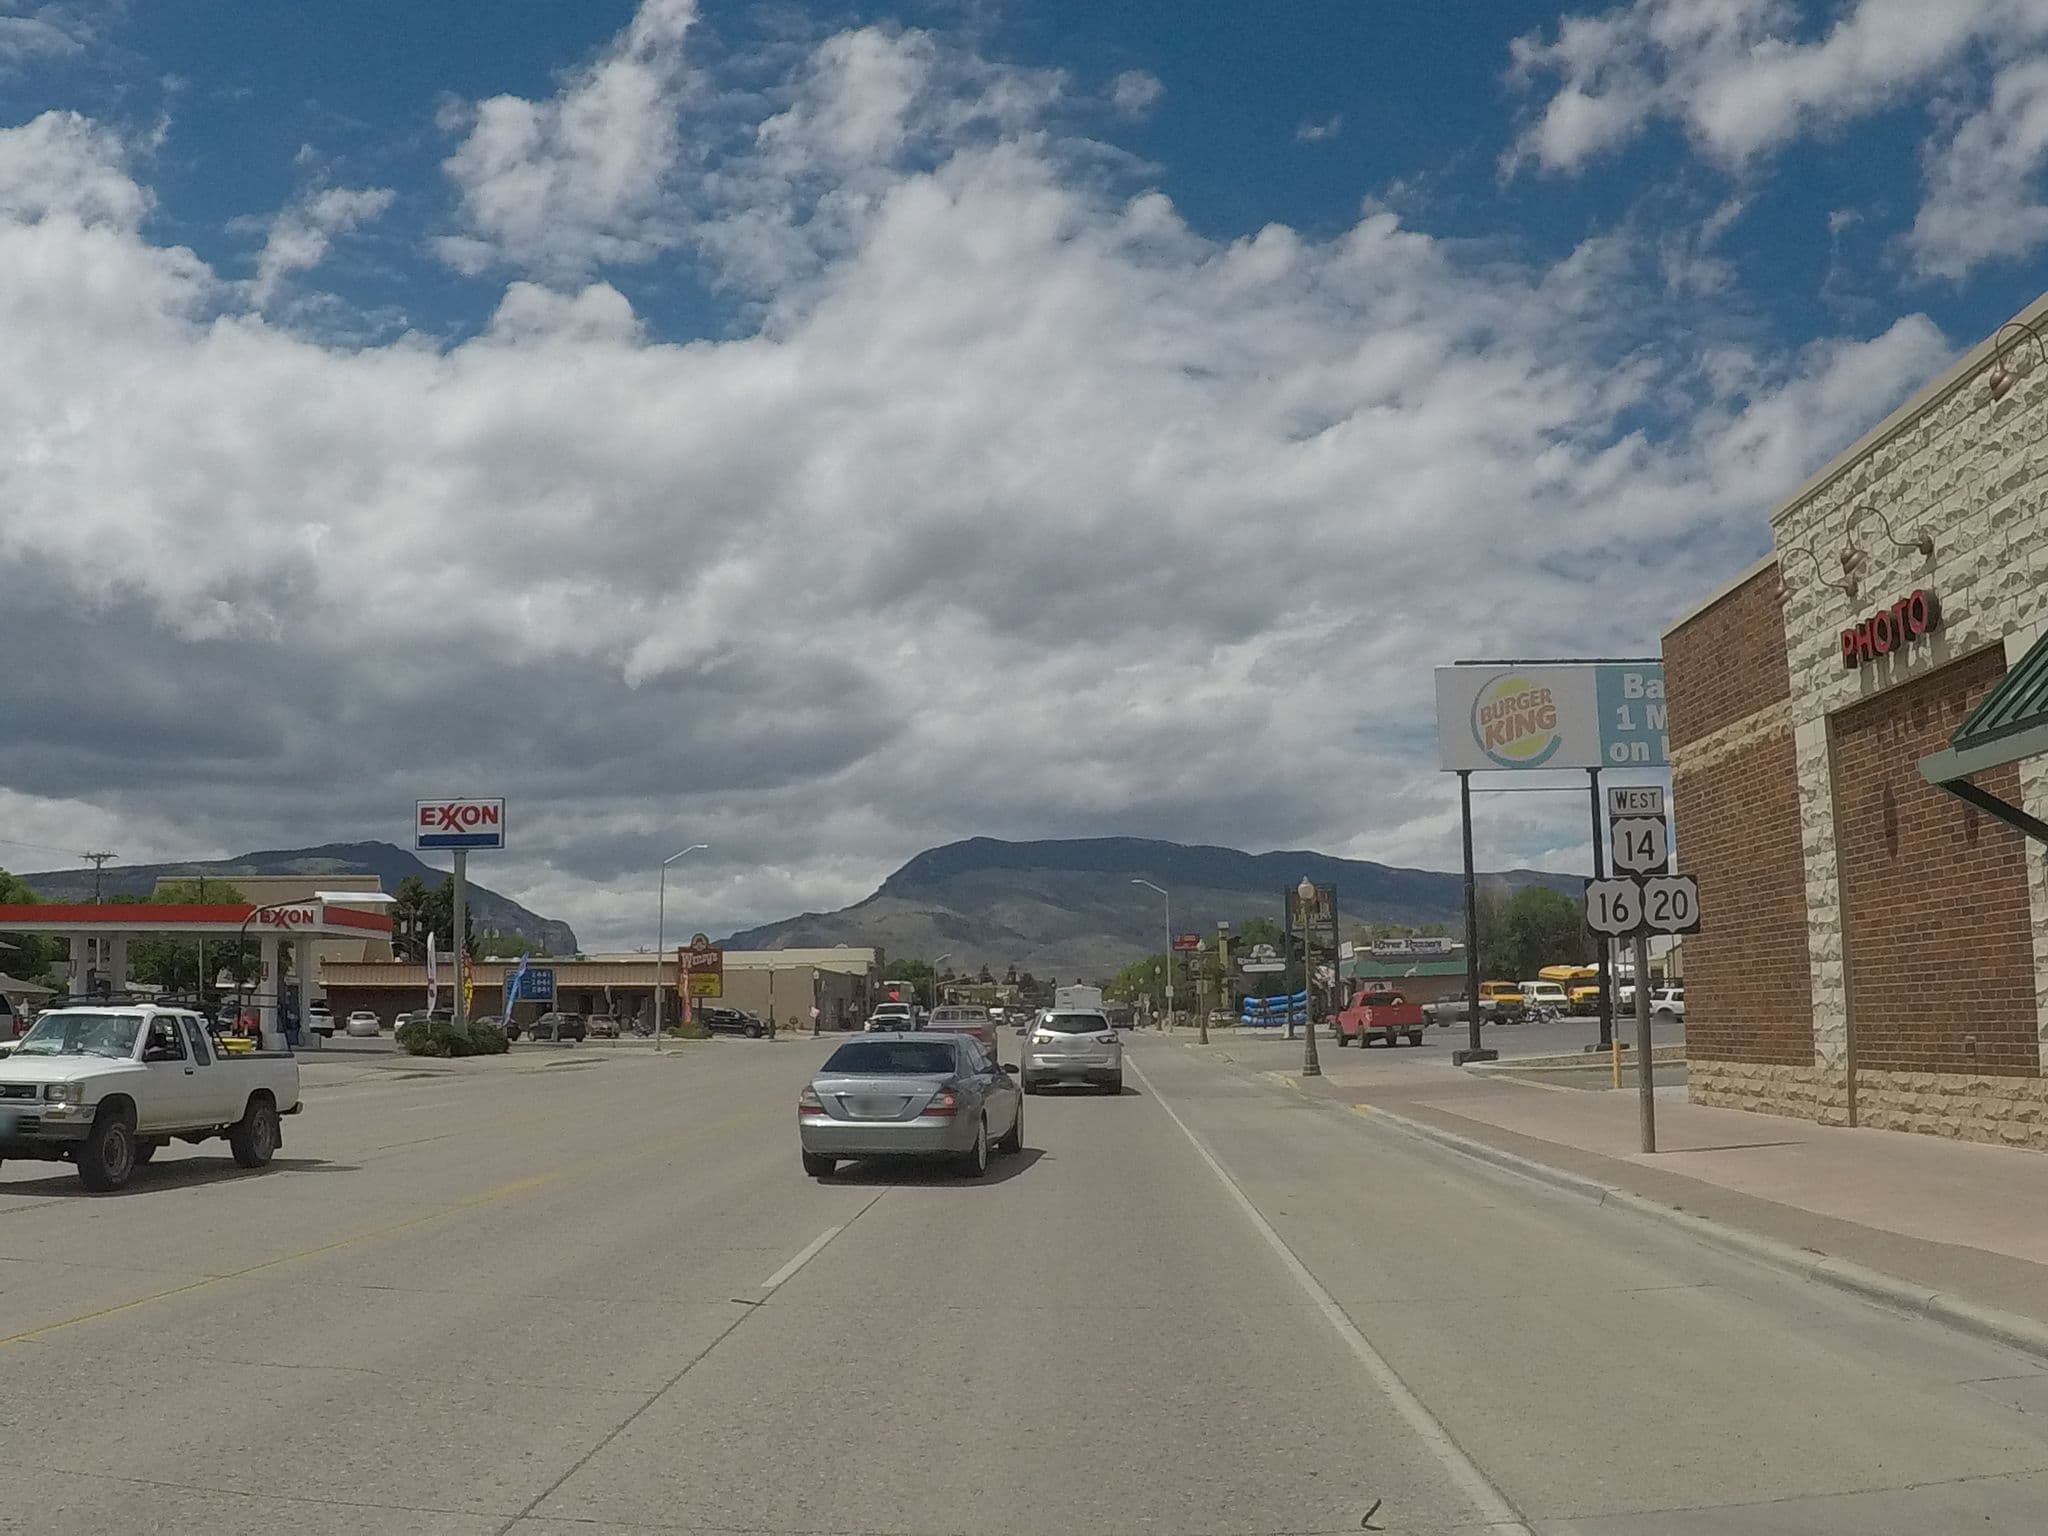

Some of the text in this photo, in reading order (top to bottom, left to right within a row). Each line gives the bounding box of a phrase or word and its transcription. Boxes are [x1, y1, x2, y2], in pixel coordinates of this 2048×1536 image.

[1841, 589, 1936, 668] PHOTO
[1481, 688, 1552, 725] BURGER
[1616, 704, 1636, 730] 1
[1486, 705, 1557, 749] KING
[1609, 741, 1650, 762] on
[1615, 790, 1657, 809] WEST
[421, 803, 498, 832] EXXON
[1624, 830, 1655, 862] 14
[260, 908, 314, 929] EXXON
[1599, 892, 1629, 924] 16
[1652, 889, 1688, 921] 20
